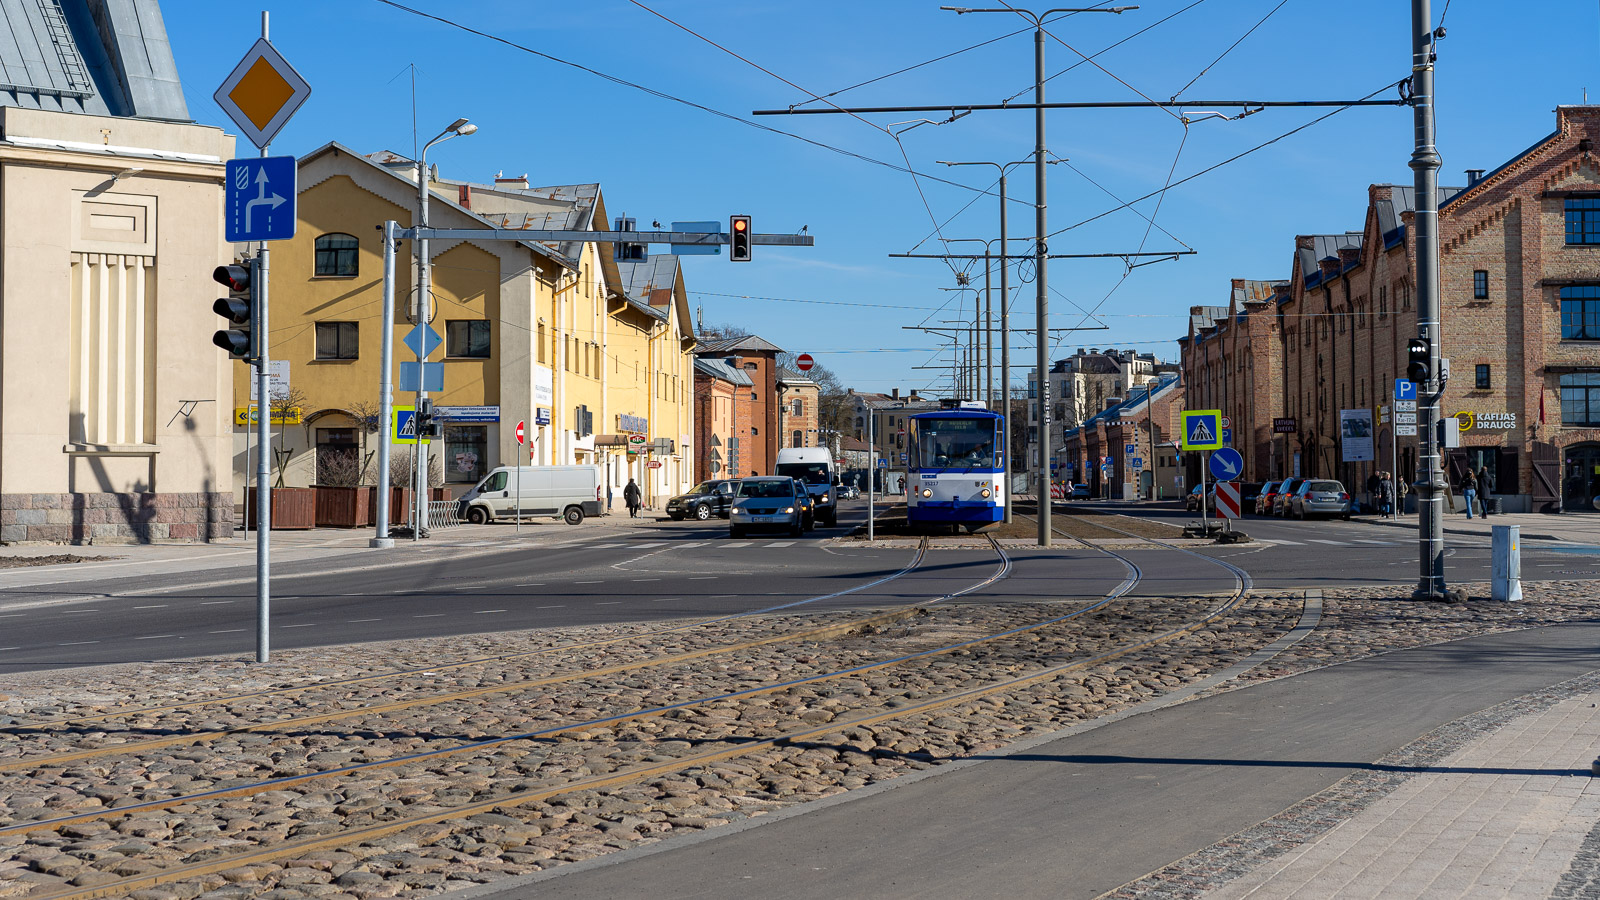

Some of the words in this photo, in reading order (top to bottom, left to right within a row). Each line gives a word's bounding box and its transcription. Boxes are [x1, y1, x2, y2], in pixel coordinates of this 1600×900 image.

[1400, 381, 1412, 397] P
[1476, 413, 1516, 421] KAFIJAS
[1476, 421, 1516, 429] DRAUGS
